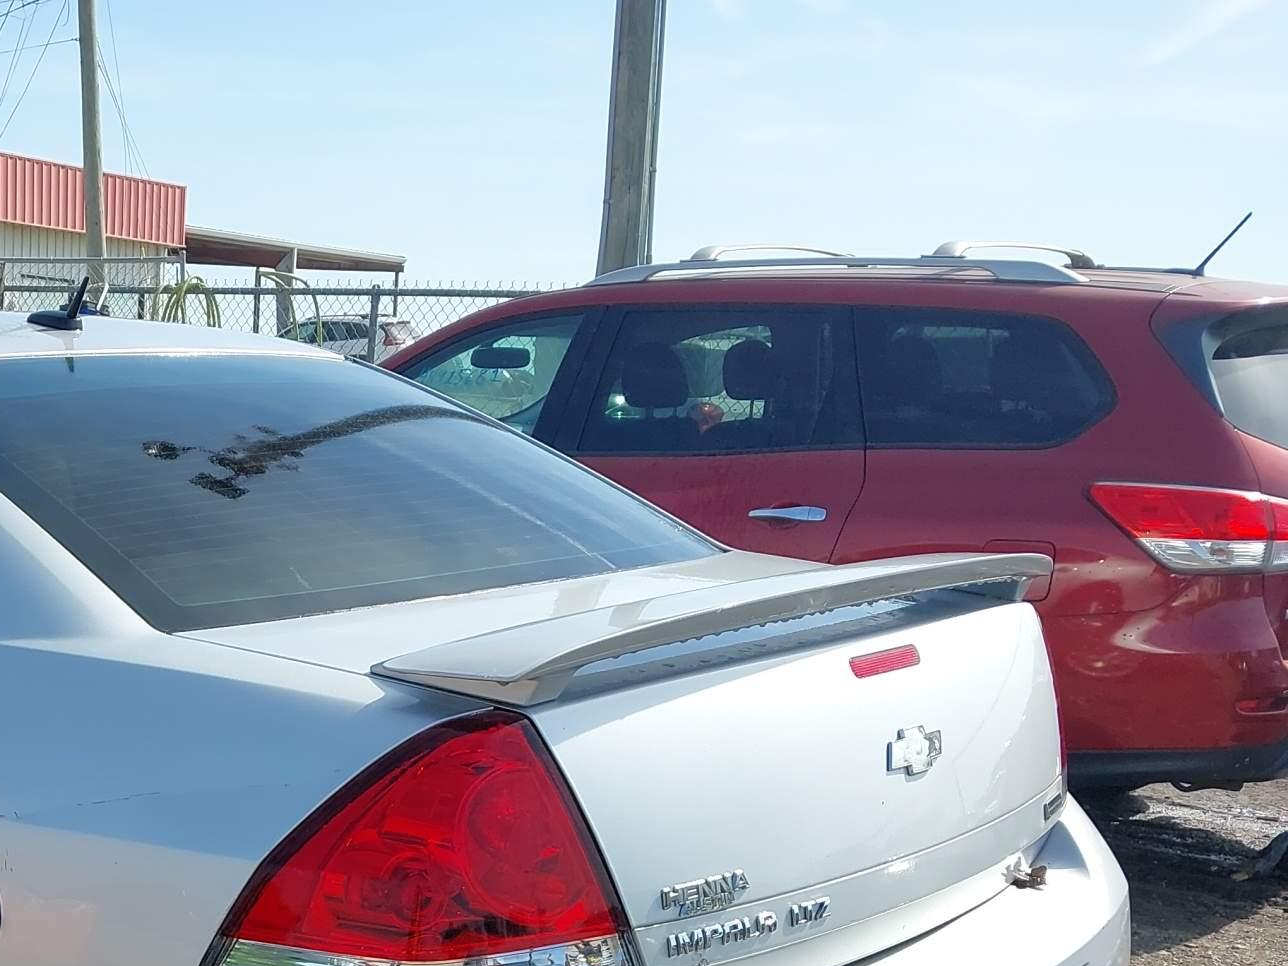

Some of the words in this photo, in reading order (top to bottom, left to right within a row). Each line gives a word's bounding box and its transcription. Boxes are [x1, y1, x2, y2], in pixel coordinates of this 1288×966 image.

[660, 868, 751, 911] HENNA
[667, 910, 778, 959] IMPALA
[789, 895, 832, 928] LTZ
